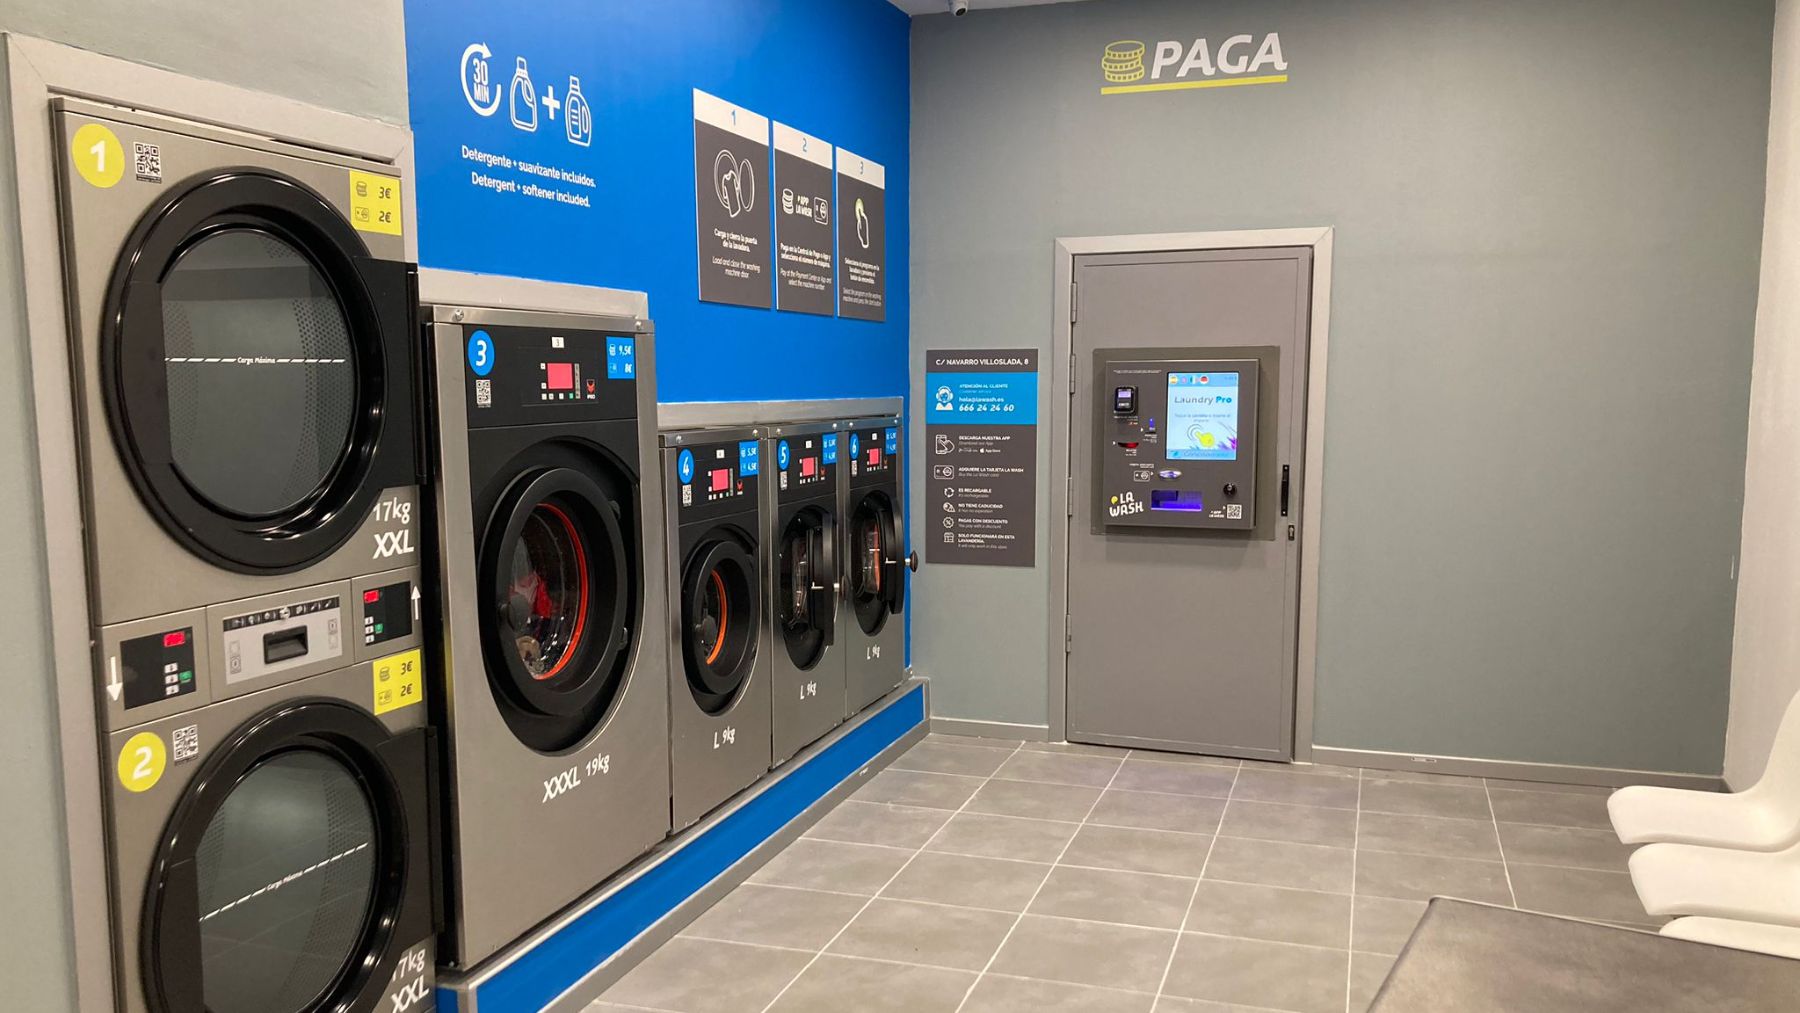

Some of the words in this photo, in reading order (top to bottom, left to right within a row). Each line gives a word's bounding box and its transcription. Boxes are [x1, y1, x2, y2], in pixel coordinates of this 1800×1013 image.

[1151, 32, 1288, 79] PAGA
[473, 58, 488, 84] 30
[473, 83, 490, 104] MIN
[730, 110, 737, 126] 1
[802, 138, 808, 153] 2
[89, 139, 107, 173] 1
[461, 145, 512, 168] Detergente
[518, 160, 561, 180] suavizante
[561, 168, 597, 188] incluidos.
[859, 161, 865, 176] 3
[378, 186, 392, 200] 3€
[471, 172, 516, 193] Detergent
[522, 184, 556, 200] softener
[556, 189, 591, 208] included.
[378, 210, 392, 224] 2€
[237, 356, 254, 365] Carga
[475, 339, 488, 367] 3
[979, 358, 1023, 367] VILLOSLADA,
[959, 404, 975, 412] 666
[976, 404, 988, 412] 24
[990, 404, 1001, 412] 24
[1003, 404, 1015, 412] 60
[1174, 396, 1214, 406] Laundry
[1216, 396, 1232, 404] Pro
[851, 439, 857, 454] 6
[780, 447, 787, 464] 5
[682, 459, 690, 477] 4
[1120, 491, 1135, 504] LA
[373, 497, 411, 525] 17kg
[1109, 501, 1144, 518] WASH
[372, 529, 414, 559] XXL
[866, 646, 871, 660] L
[872, 645, 881, 659] 9kg
[401, 660, 414, 676] 3€
[400, 684, 413, 698] 2€
[800, 683, 806, 700] L
[806, 680, 817, 696] 9kg
[713, 732, 720, 749] L
[722, 726, 736, 745] 9kg
[132, 747, 154, 780] 2
[542, 766, 582, 804] XXXL
[586, 753, 610, 778] 19kg
[390, 975, 430, 1013] XXL
